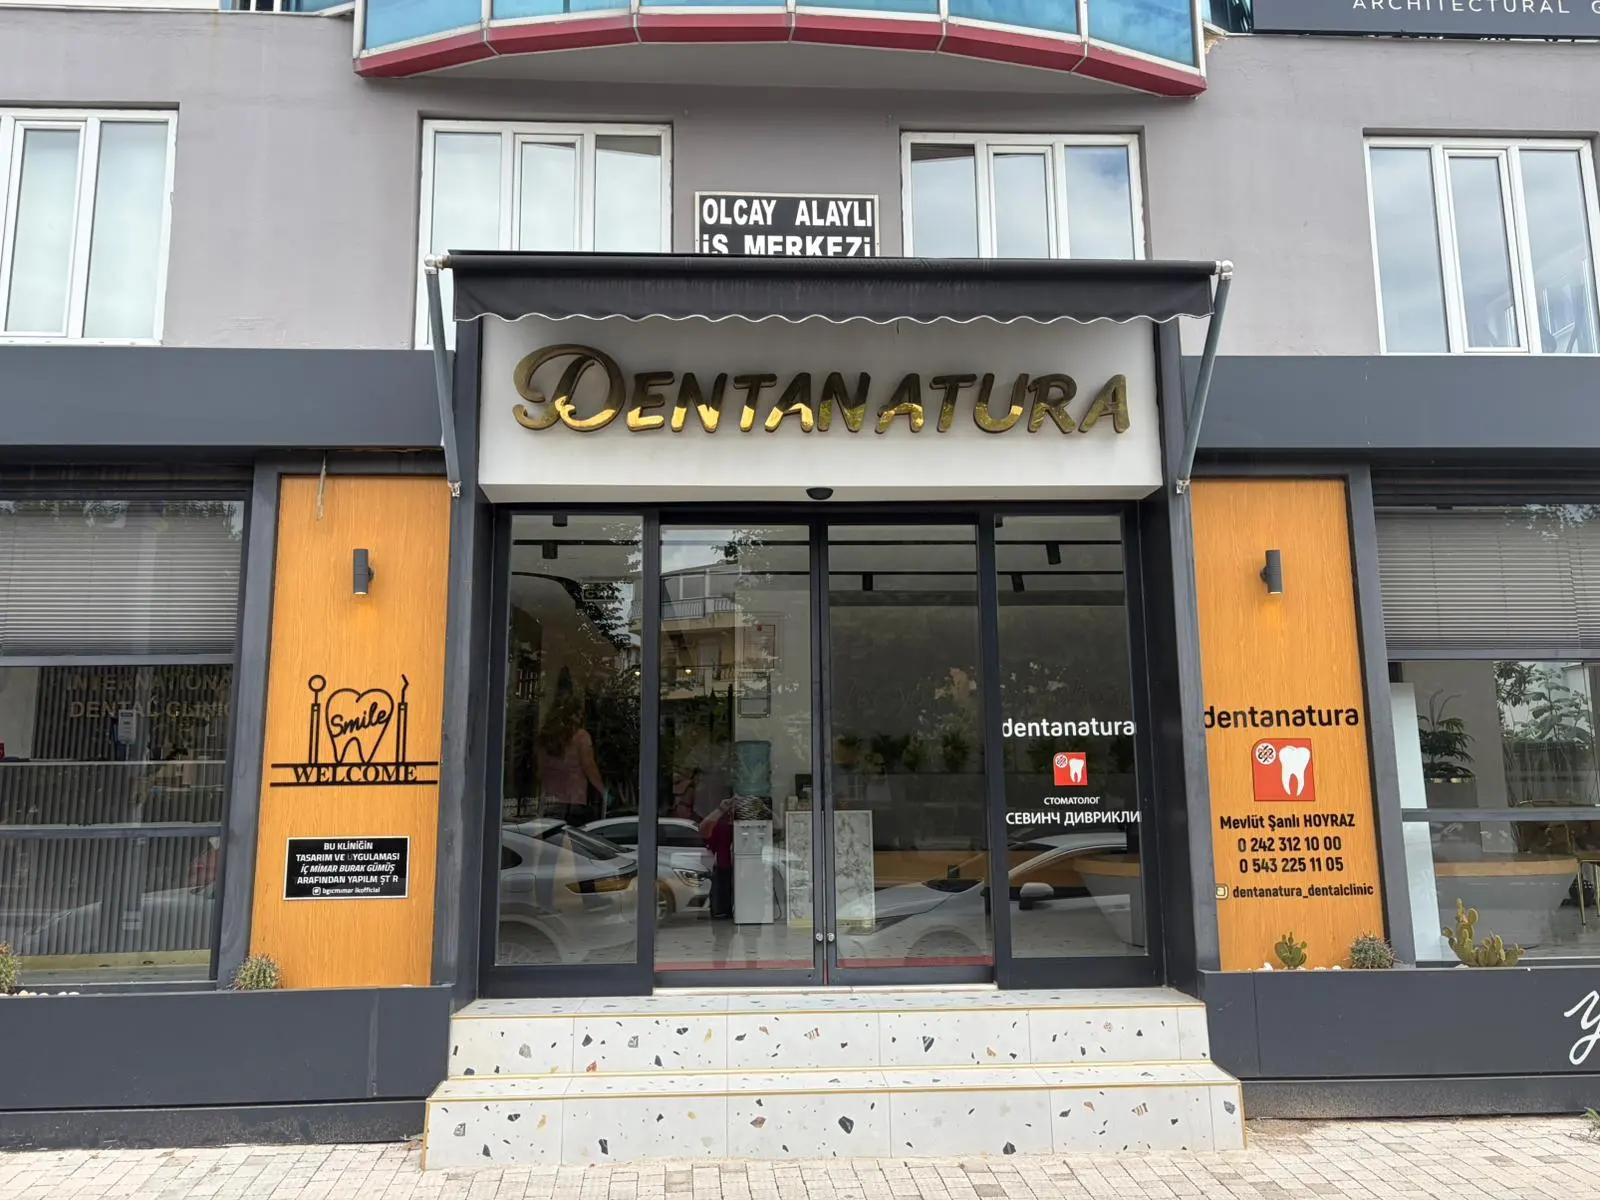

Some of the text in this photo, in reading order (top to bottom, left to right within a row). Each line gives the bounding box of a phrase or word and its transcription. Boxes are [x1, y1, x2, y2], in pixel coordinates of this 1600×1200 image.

[702, 198, 872, 227] OLCAY ALAYLI
[330, 701, 391, 738] Smile
[1204, 705, 1359, 728] dentanatura
[1002, 718, 1137, 738] dentanatura
[292, 765, 418, 784] WELCOME
[1043, 796, 1101, 806] СТОМАТОЛОГ
[1006, 811, 1142, 826] СЕВИНЧ ДИВРИКЛИ
[1220, 814, 1356, 832] Mevlüt Şanlı HOYRAZ
[337, 841, 374, 850] KLİNİĞİN
[1238, 836, 1342, 852] 0 242 312 10 00
[296, 853, 333, 862] TASARIM
[334, 853, 345, 861] VE
[1239, 857, 1344, 873] 0 543 225 11 05
[310, 863, 337, 873] MİMAR
[339, 864, 366, 872] BURAK
[297, 875, 345, 884] ARAFINDAN
[1232, 883, 1375, 899] dentanatura_dentalclinic
